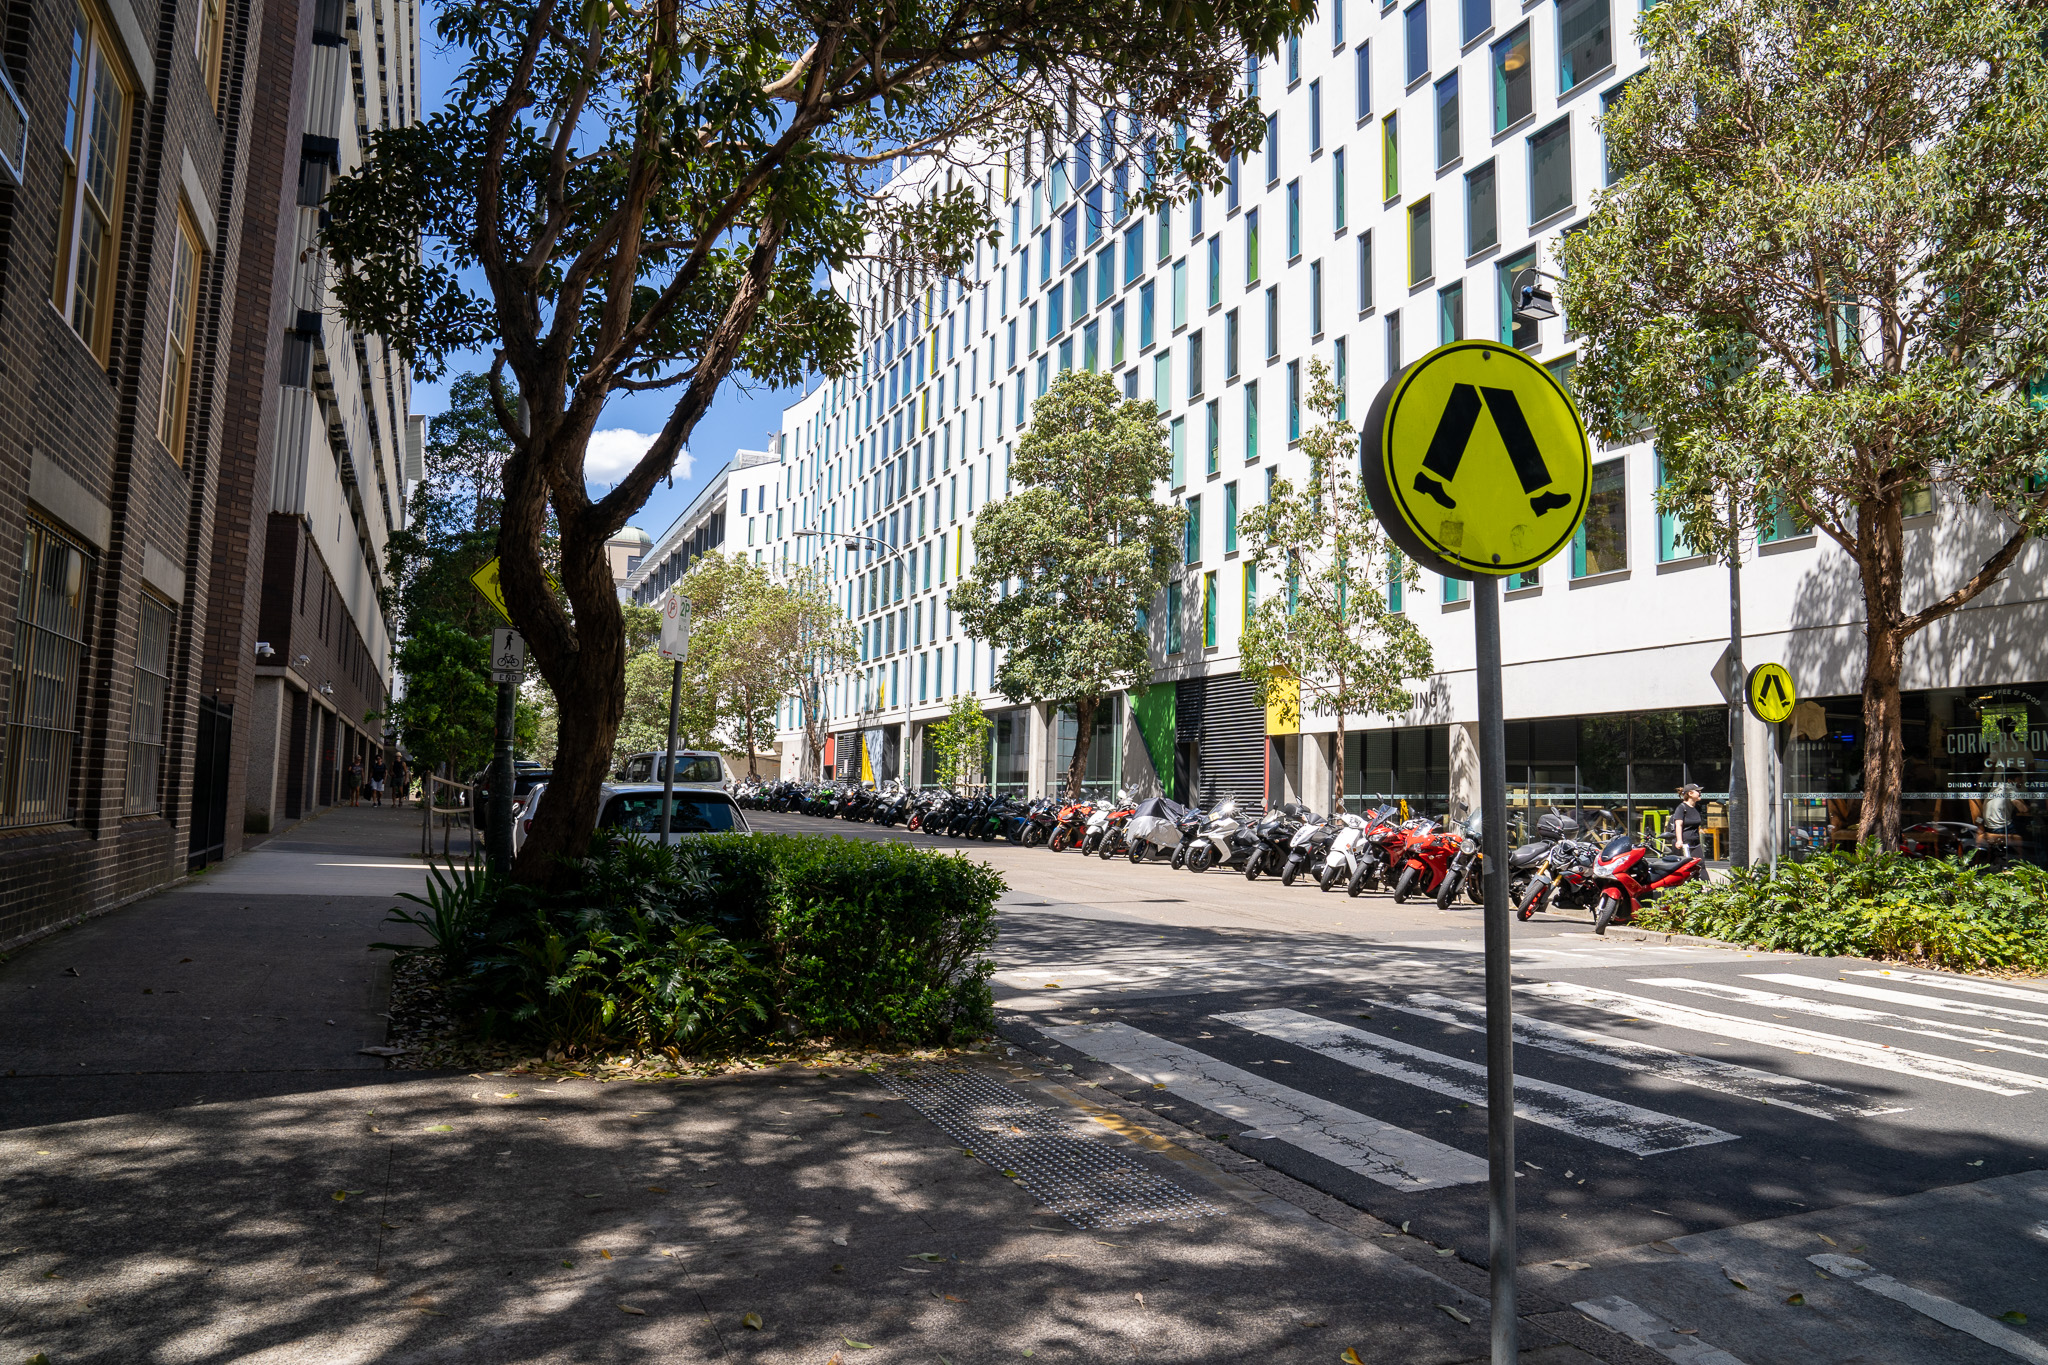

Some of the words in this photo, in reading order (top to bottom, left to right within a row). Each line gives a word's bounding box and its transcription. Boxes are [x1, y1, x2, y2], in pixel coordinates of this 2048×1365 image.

[680, 602, 690, 617] 2P
[499, 673, 517, 682] END
[2021, 692, 2041, 706] FOOD
[1984, 757, 2026, 768] CAFE
